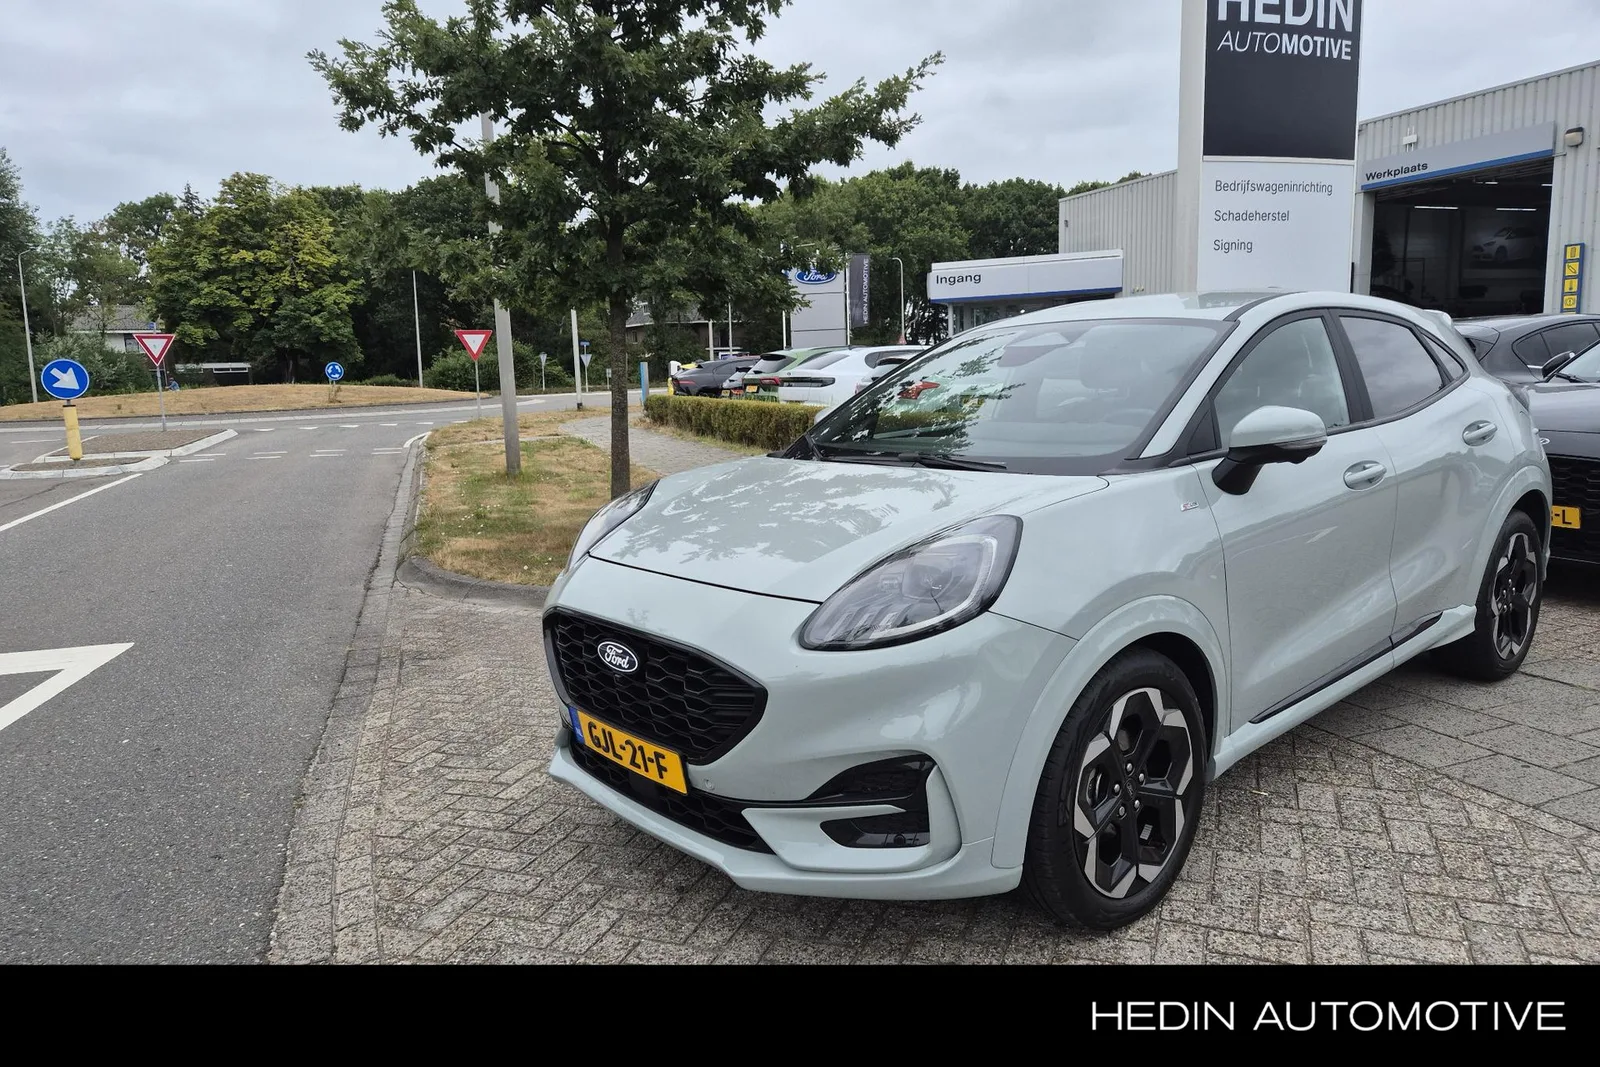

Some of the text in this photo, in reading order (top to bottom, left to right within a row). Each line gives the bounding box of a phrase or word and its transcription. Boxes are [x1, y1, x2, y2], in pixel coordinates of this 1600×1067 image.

[1217, 0, 1354, 32] HEDIN
[1217, 30, 1352, 61] AUTOMOTIVE
[1365, 162, 1428, 181] Werkplaats
[1215, 179, 1333, 196] Bedrijfswageninrichting
[1214, 209, 1290, 222] Schadeherstel
[1213, 238, 1253, 254] Signing
[936, 274, 982, 286] Ingang
[604, 644, 630, 669] Ford
[587, 720, 669, 780] GJL-21-F
